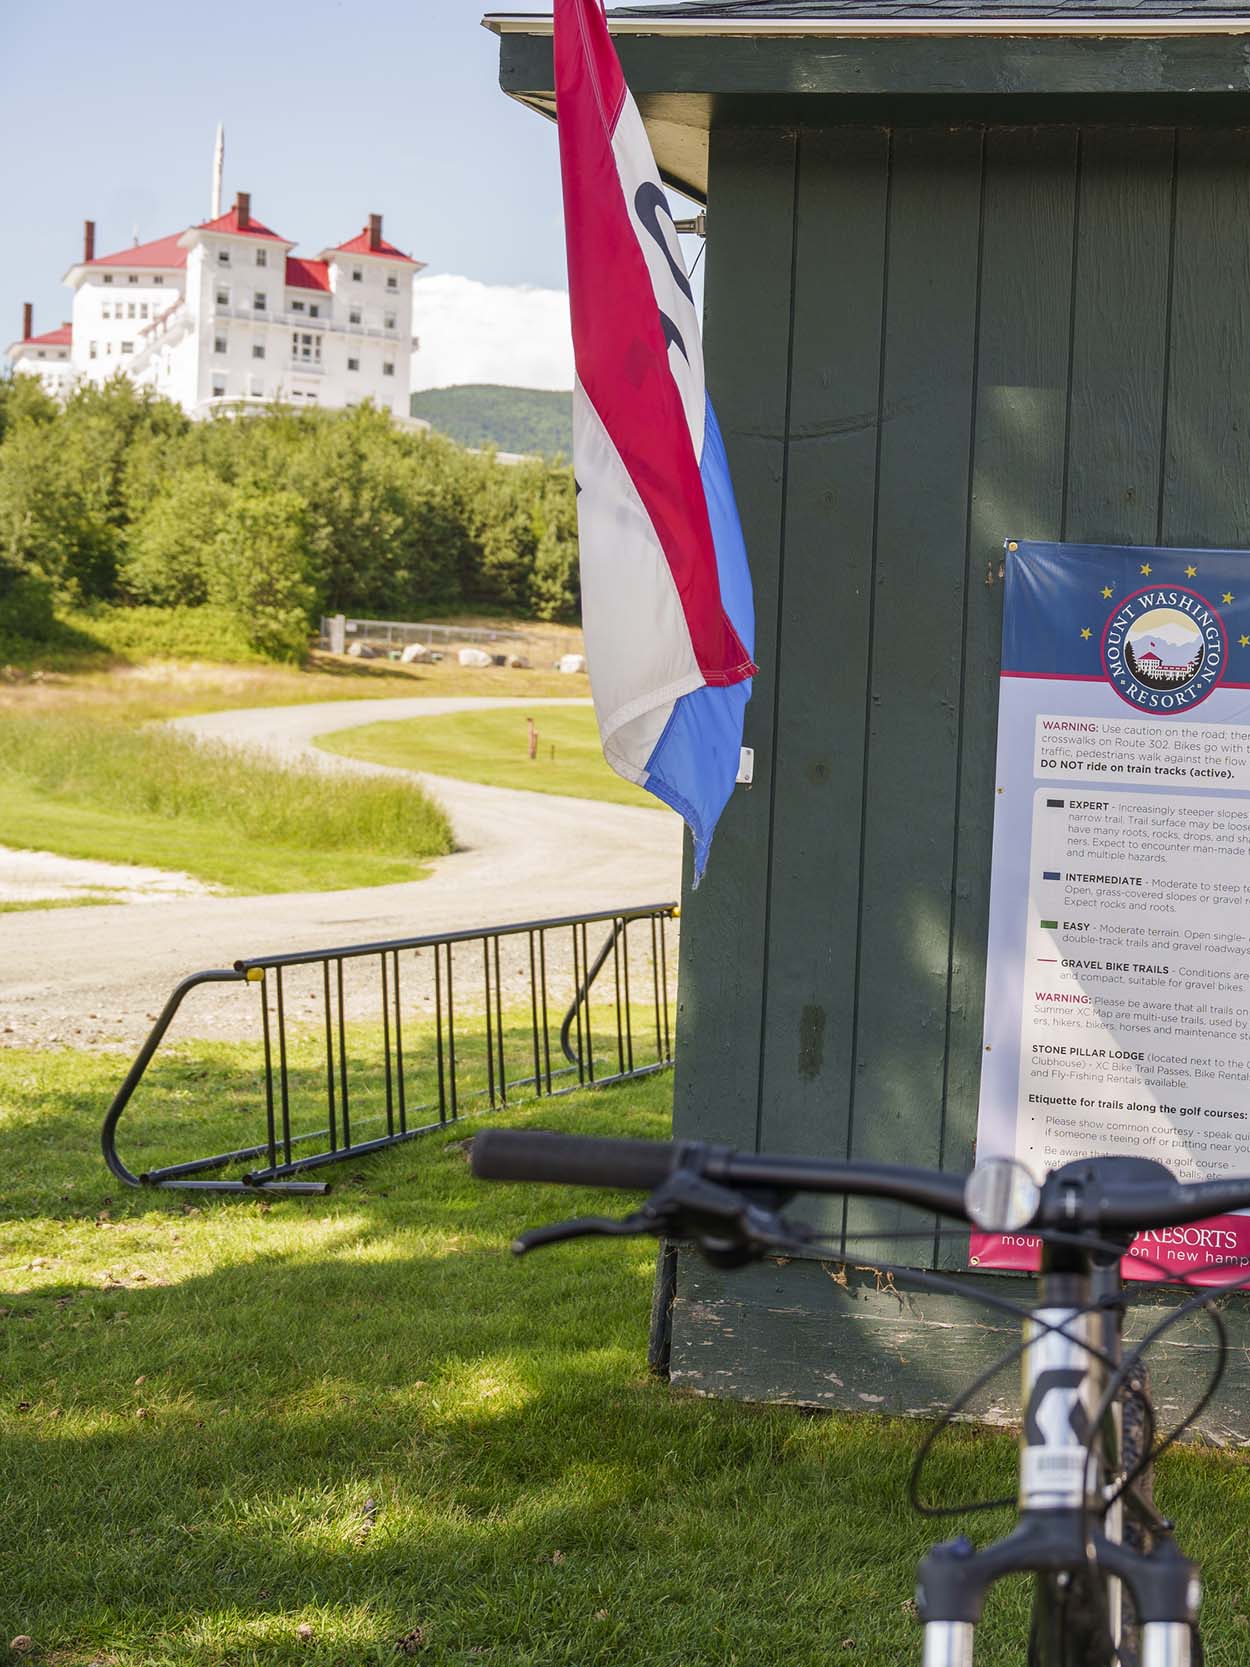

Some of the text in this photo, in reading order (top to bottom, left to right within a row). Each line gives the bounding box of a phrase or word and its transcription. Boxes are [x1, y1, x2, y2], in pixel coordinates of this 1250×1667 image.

[1107, 592, 1221, 683] MOUNT WASHINGTON
[1125, 683, 1198, 707] RESORT
[1042, 721, 1099, 732] WARNING:
[1102, 724, 1121, 733] Use
[1123, 725, 1161, 735] caution
[1181, 729, 1198, 738] the
[1201, 730, 1226, 740] road;
[1041, 734, 1097, 745] crosswalks
[1098, 738, 1112, 746] on
[1114, 738, 1146, 748] Route
[1147, 739, 1170, 749] 302.
[1173, 741, 1202, 751] Bikes
[1204, 744, 1218, 754] go
[1220, 743, 1243, 753] with
[1040, 746, 1073, 757] traffic,
[1075, 748, 1135, 762] pedestrians
[1138, 751, 1162, 761] walk
[1163, 753, 1201, 765] against
[1204, 755, 1222, 764] the
[1224, 756, 1248, 766] flow
[1040, 759, 1057, 768] DO
[1060, 760, 1084, 770] NOT
[1086, 762, 1107, 771] ride
[1126, 764, 1151, 774] train
[1154, 765, 1188, 776] tracks
[1189, 767, 1234, 779] (active).
[1069, 800, 1109, 810] EXPERT
[1120, 803, 1175, 816] Increasingly
[1178, 807, 1214, 819] steeper
[1217, 809, 1248, 821] slopes
[1066, 848, 1168, 863] and multiple hazards.
[1065, 873, 1142, 886] INTERMEDIATE
[1152, 878, 1198, 889] Moderate
[1200, 882, 1210, 890] to
[1213, 882, 1240, 894] steep
[1063, 885, 1093, 897] Open,
[1095, 887, 1163, 901] grass-covered
[1164, 891, 1197, 903] slopes
[1212, 894, 1242, 906] gravel
[1063, 897, 1176, 912] Expect rocks and roots.
[1062, 921, 1090, 931] EASY
[1099, 924, 1145, 935] Moderate
[1148, 927, 1180, 937] terrain.
[1183, 930, 1210, 942] Open
[1213, 931, 1246, 944] single-
[1062, 934, 1124, 946] double-track
[1125, 938, 1149, 948] trails
[1151, 939, 1170, 949] and
[1171, 941, 1201, 953] gravel
[1060, 959, 1103, 970] GRAVEL
[1105, 962, 1129, 972] BIKE
[1132, 963, 1169, 974] TRAILS
[1178, 967, 1230, 979] Conditions
[1234, 972, 1249, 980] are
[1034, 992, 1091, 1004] WARNING:
[1094, 996, 1125, 1007] Please
[1127, 999, 1140, 1008] be
[1142, 1001, 1171, 1010] aware
[1174, 1002, 1194, 1011] that
[1196, 1003, 1207, 1012] all
[1209, 1004, 1233, 1014] trails
[1032, 1044, 1066, 1055] STONE
[1069, 1047, 1106, 1058] PILLAR
[1108, 1050, 1144, 1060] LODGE
[1147, 1052, 1187, 1064] (located
[1190, 1055, 1211, 1065] next
[1214, 1057, 1224, 1066] to
[1228, 1058, 1243, 1067] the
[1030, 1068, 1188, 1088] and Fly-Fishing Rentals available.
[1028, 1094, 1248, 1118] Etiquette for trails along the golf courses:
[1145, 1226, 1238, 1249] RESORTS
[1166, 1249, 1199, 1263] new
